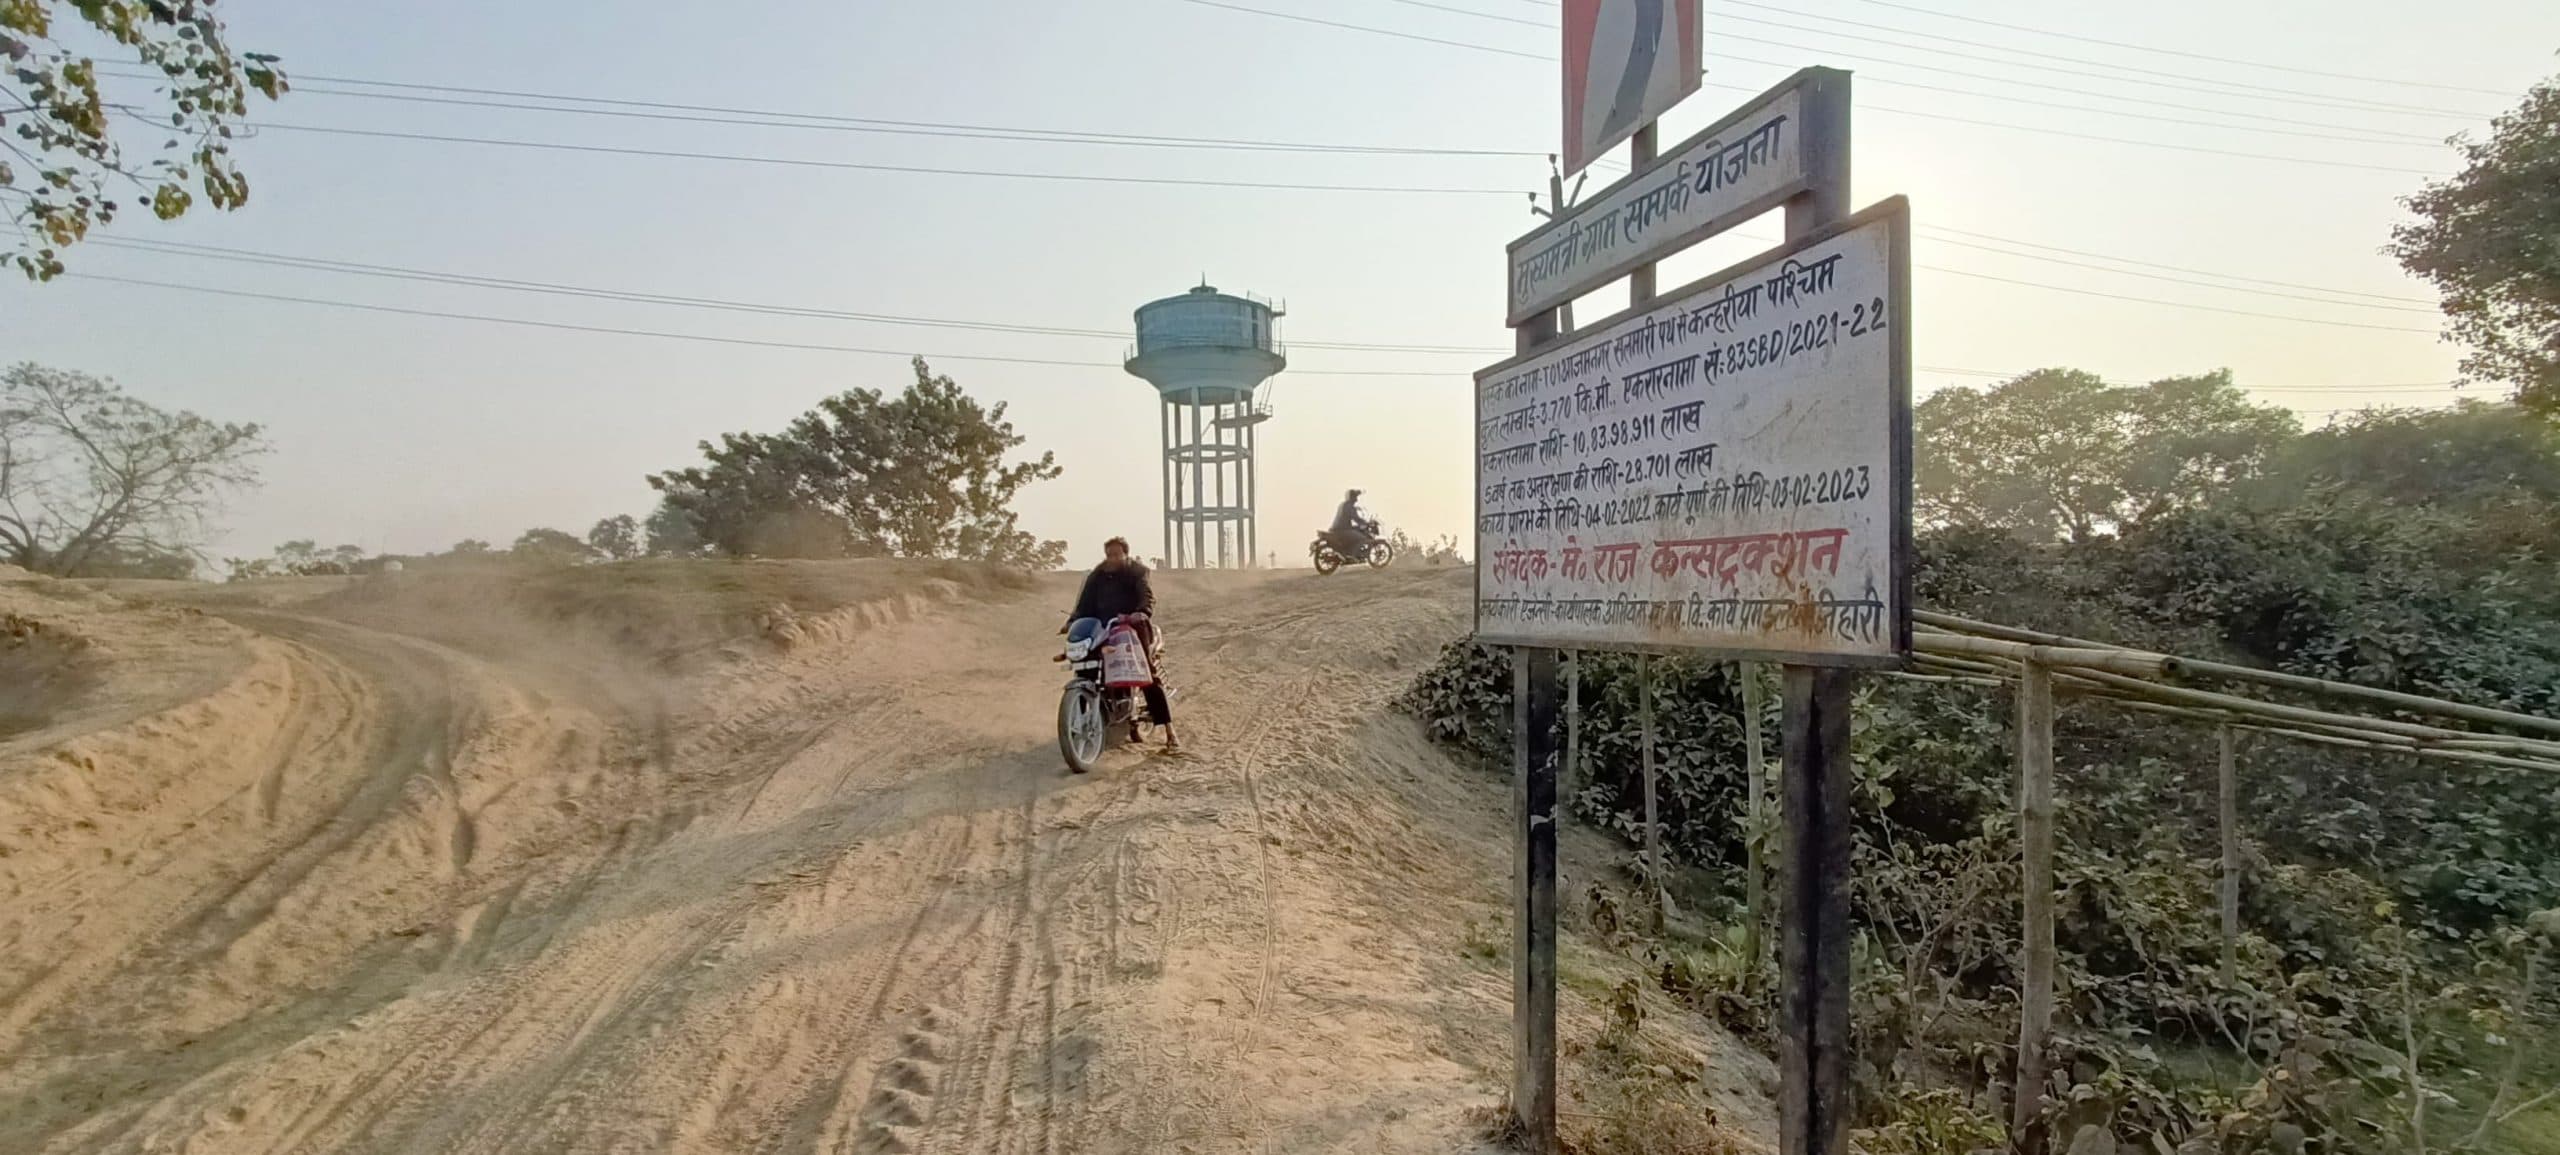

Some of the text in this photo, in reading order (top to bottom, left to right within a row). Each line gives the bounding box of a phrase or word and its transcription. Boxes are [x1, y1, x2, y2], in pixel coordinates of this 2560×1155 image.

[1516, 115, 1786, 304] मुख्यमंत्री ग्राम सम्पर्क योजना
[1505, 375, 1520, 399] का
[1659, 317, 1676, 349] पथ
[1677, 307, 1689, 344] से
[1766, 253, 1843, 308] पश्चिम
[1622, 354, 1701, 404] एकरारनामा
[1483, 442, 1537, 472] एकरारनामा
[1661, 400, 1705, 441] लाख
[1480, 505, 1506, 534] कार्य
[1535, 501, 1552, 530] की
[1655, 482, 1686, 521] कार्य
[1685, 481, 1711, 526] पूर्ण
[1709, 477, 1730, 514] की
[1508, 480, 1525, 506] तक
[1527, 471, 1573, 502] अनुरक्षण
[1573, 462, 1589, 492] की
[1675, 443, 1718, 480] लाख
[1594, 542, 1641, 584] राज
[1651, 528, 1849, 592] कन्सट्रक्शन
[1708, 587, 1742, 627] कार्य
